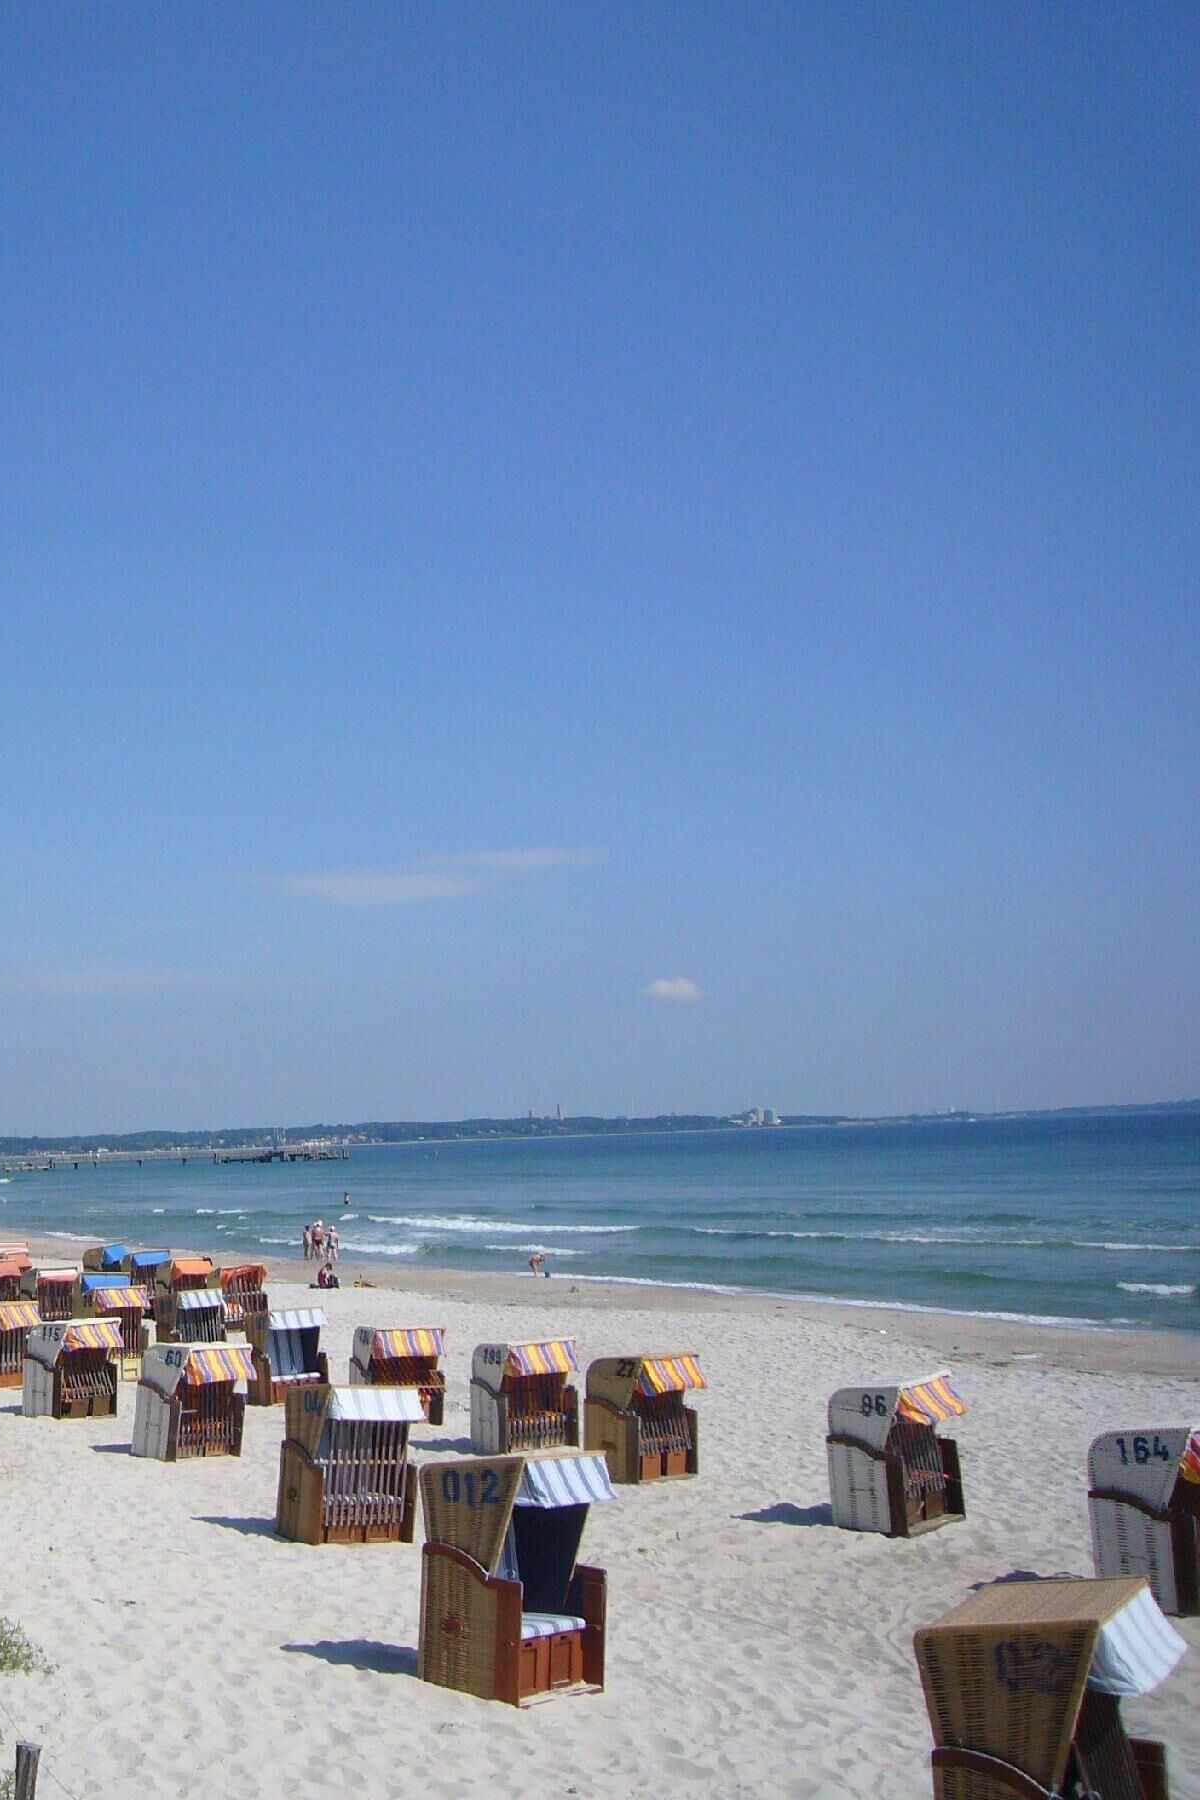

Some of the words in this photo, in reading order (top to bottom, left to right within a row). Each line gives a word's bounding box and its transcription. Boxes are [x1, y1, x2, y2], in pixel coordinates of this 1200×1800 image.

[42, 1325, 61, 1341] 115
[165, 1350, 182, 1367] 60
[1116, 1436, 1169, 1465] 164
[442, 1468, 499, 1506] 012
